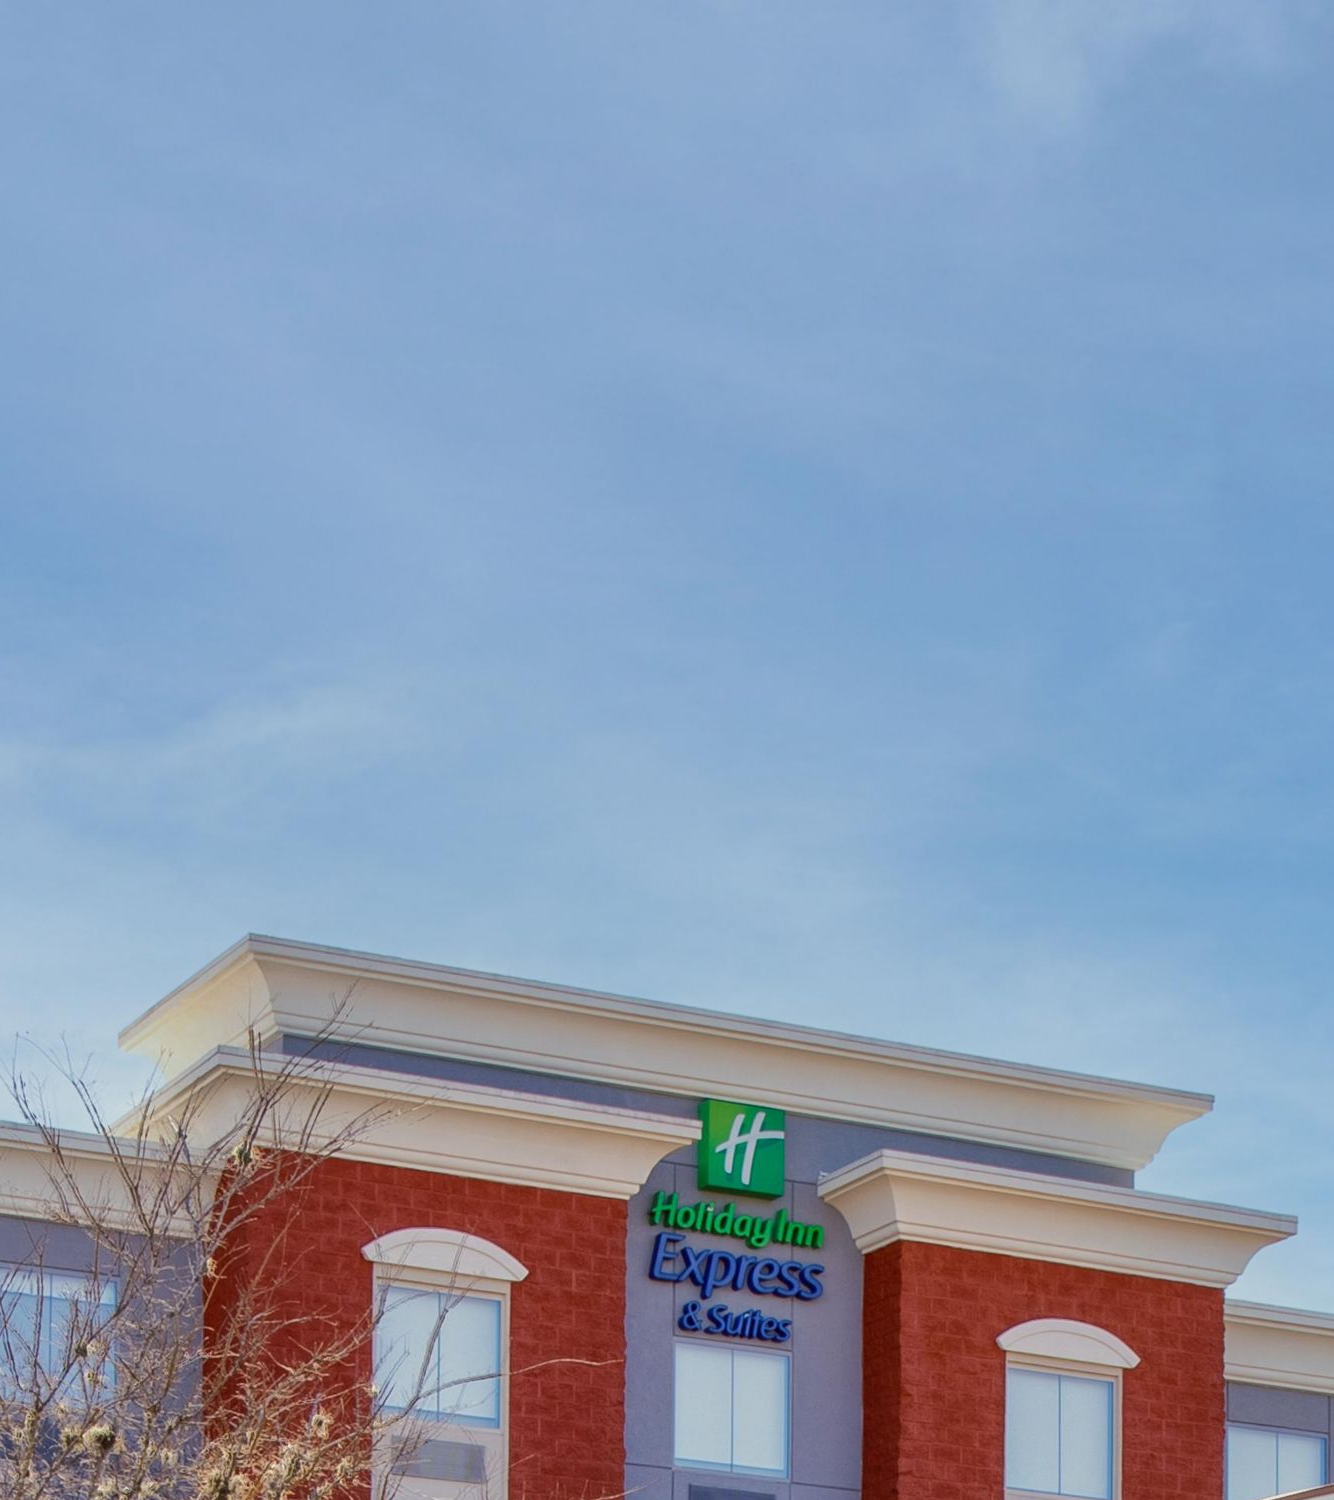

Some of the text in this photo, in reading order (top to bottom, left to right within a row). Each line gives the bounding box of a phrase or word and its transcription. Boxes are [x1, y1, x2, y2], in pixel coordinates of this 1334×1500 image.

[650, 1190, 825, 1249] Holiday Inn
[648, 1231, 825, 1300] Express
[678, 1300, 793, 1343] & Suites
